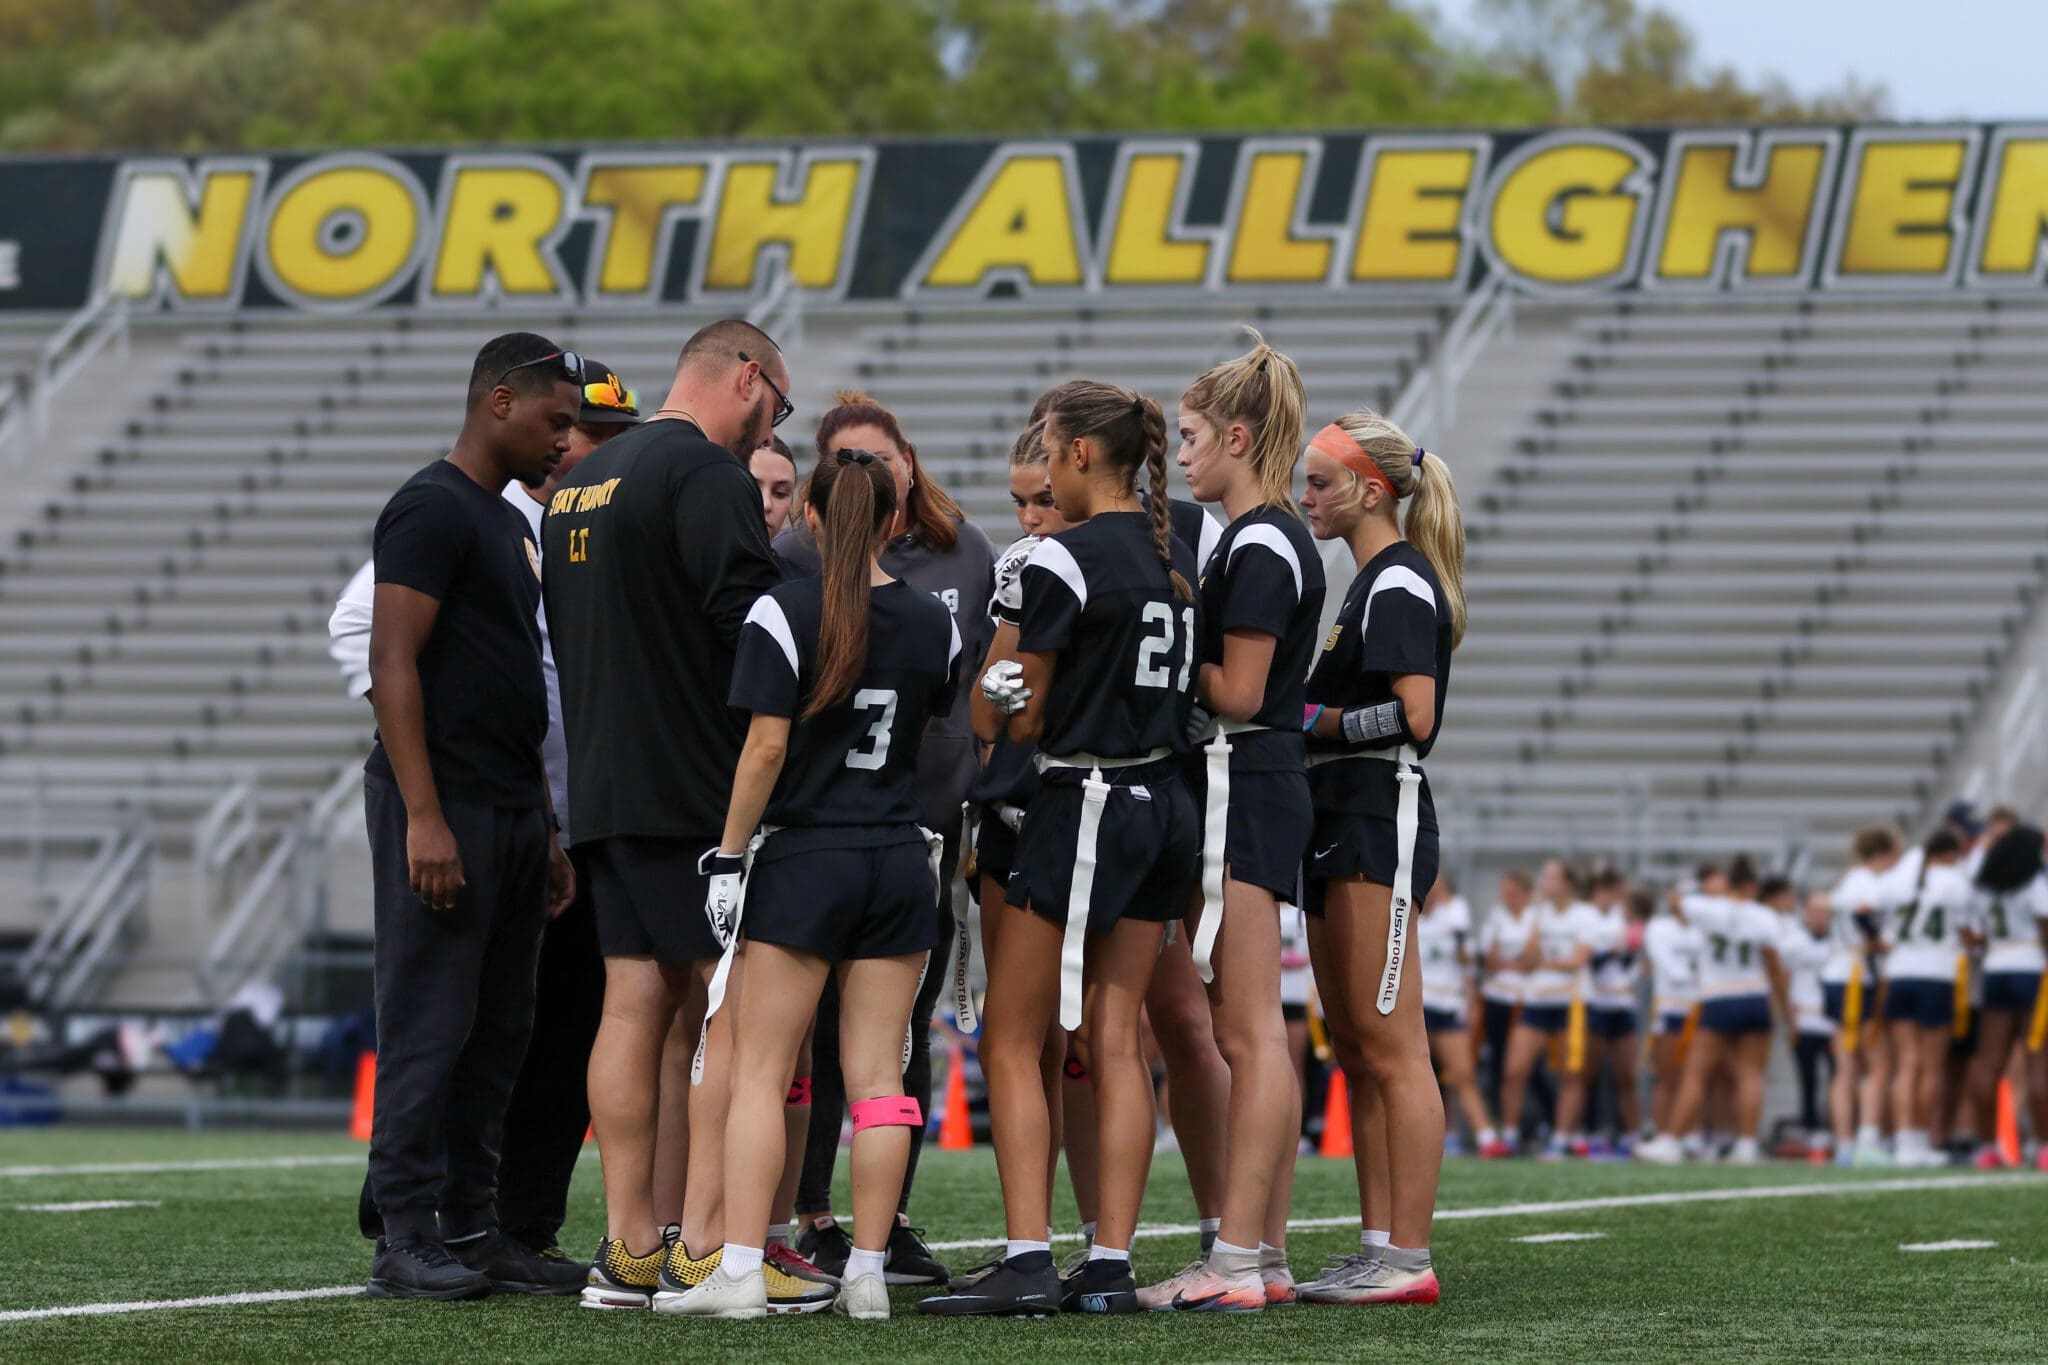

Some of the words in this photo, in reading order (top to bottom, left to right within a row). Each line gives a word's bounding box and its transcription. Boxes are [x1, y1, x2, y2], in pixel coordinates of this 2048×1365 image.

[92, 146, 878, 312] NORTH
[1134, 600, 1195, 693] 21
[845, 688, 898, 770] 3
[959, 931, 968, 960] USA
[1393, 907, 1405, 938] USA
[957, 962, 970, 1026] FOOTBALL
[1382, 939, 1401, 1003] FOOTBALL
